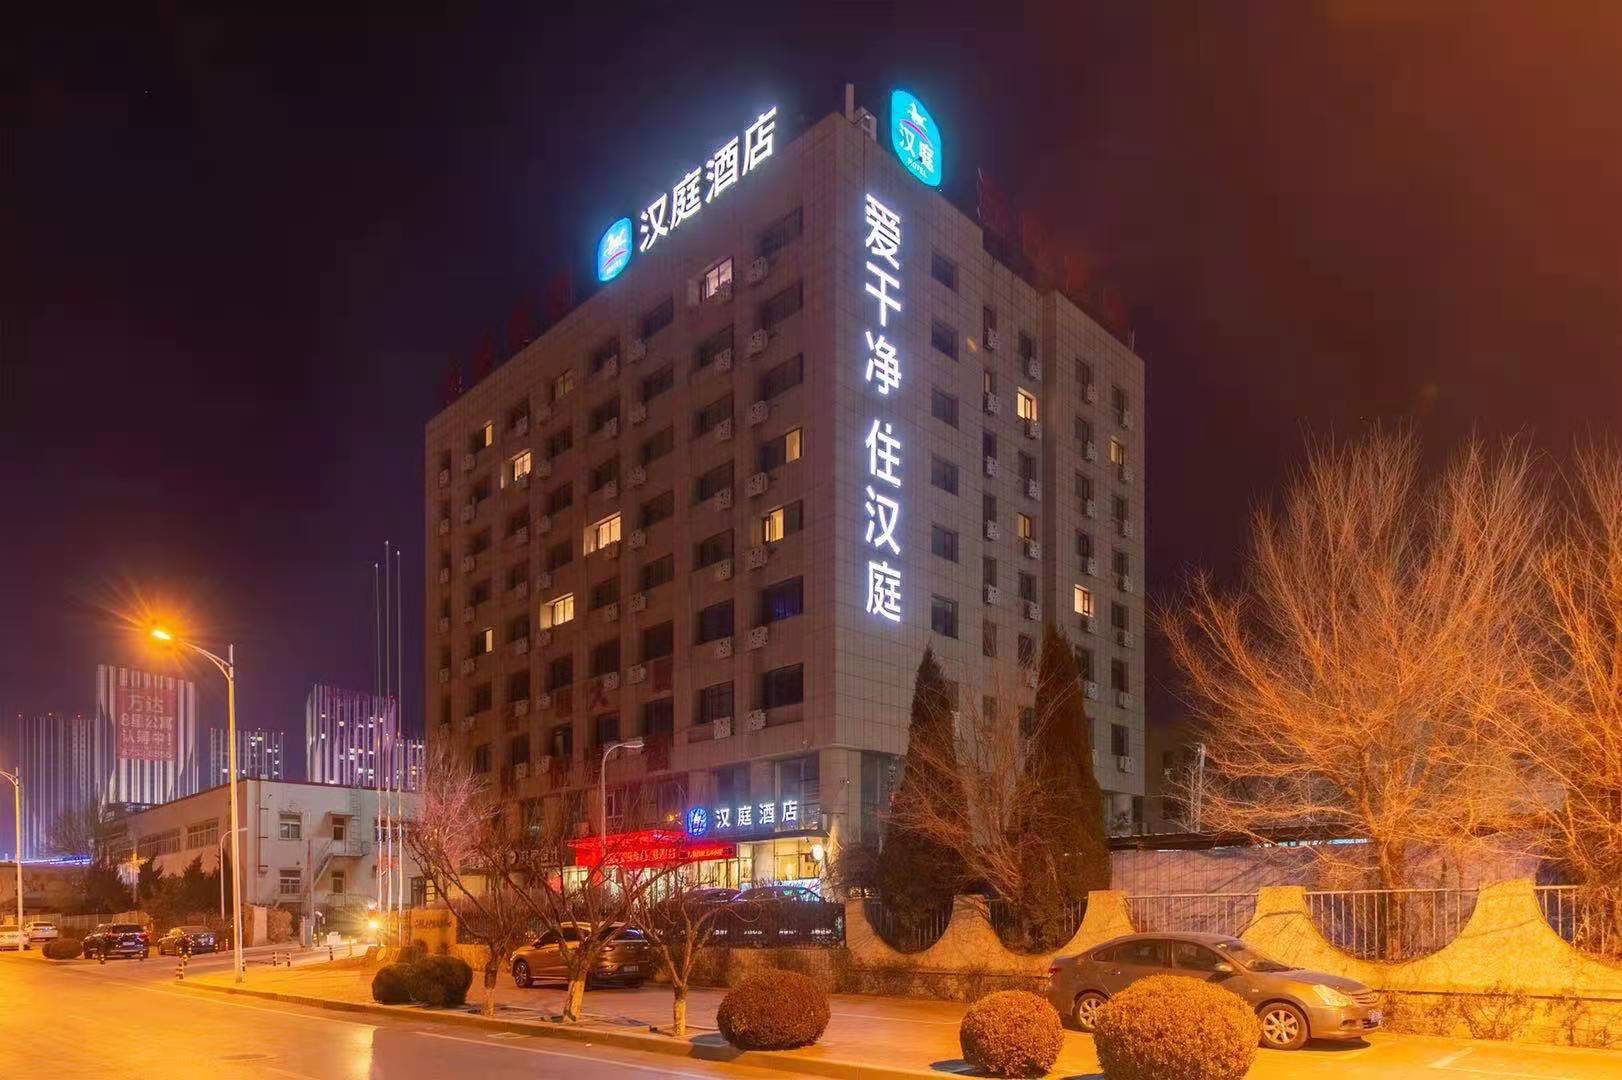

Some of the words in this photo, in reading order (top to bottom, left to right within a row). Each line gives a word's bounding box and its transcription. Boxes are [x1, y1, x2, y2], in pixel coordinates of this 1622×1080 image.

[639, 106, 777, 252] 汉庭酒店
[898, 121, 935, 175] 汉庭
[865, 193, 902, 395] 爱干净
[865, 419, 901, 622] 住汉庭
[127, 694, 164, 714] 万达
[715, 800, 798, 829] 汉庭酒店
